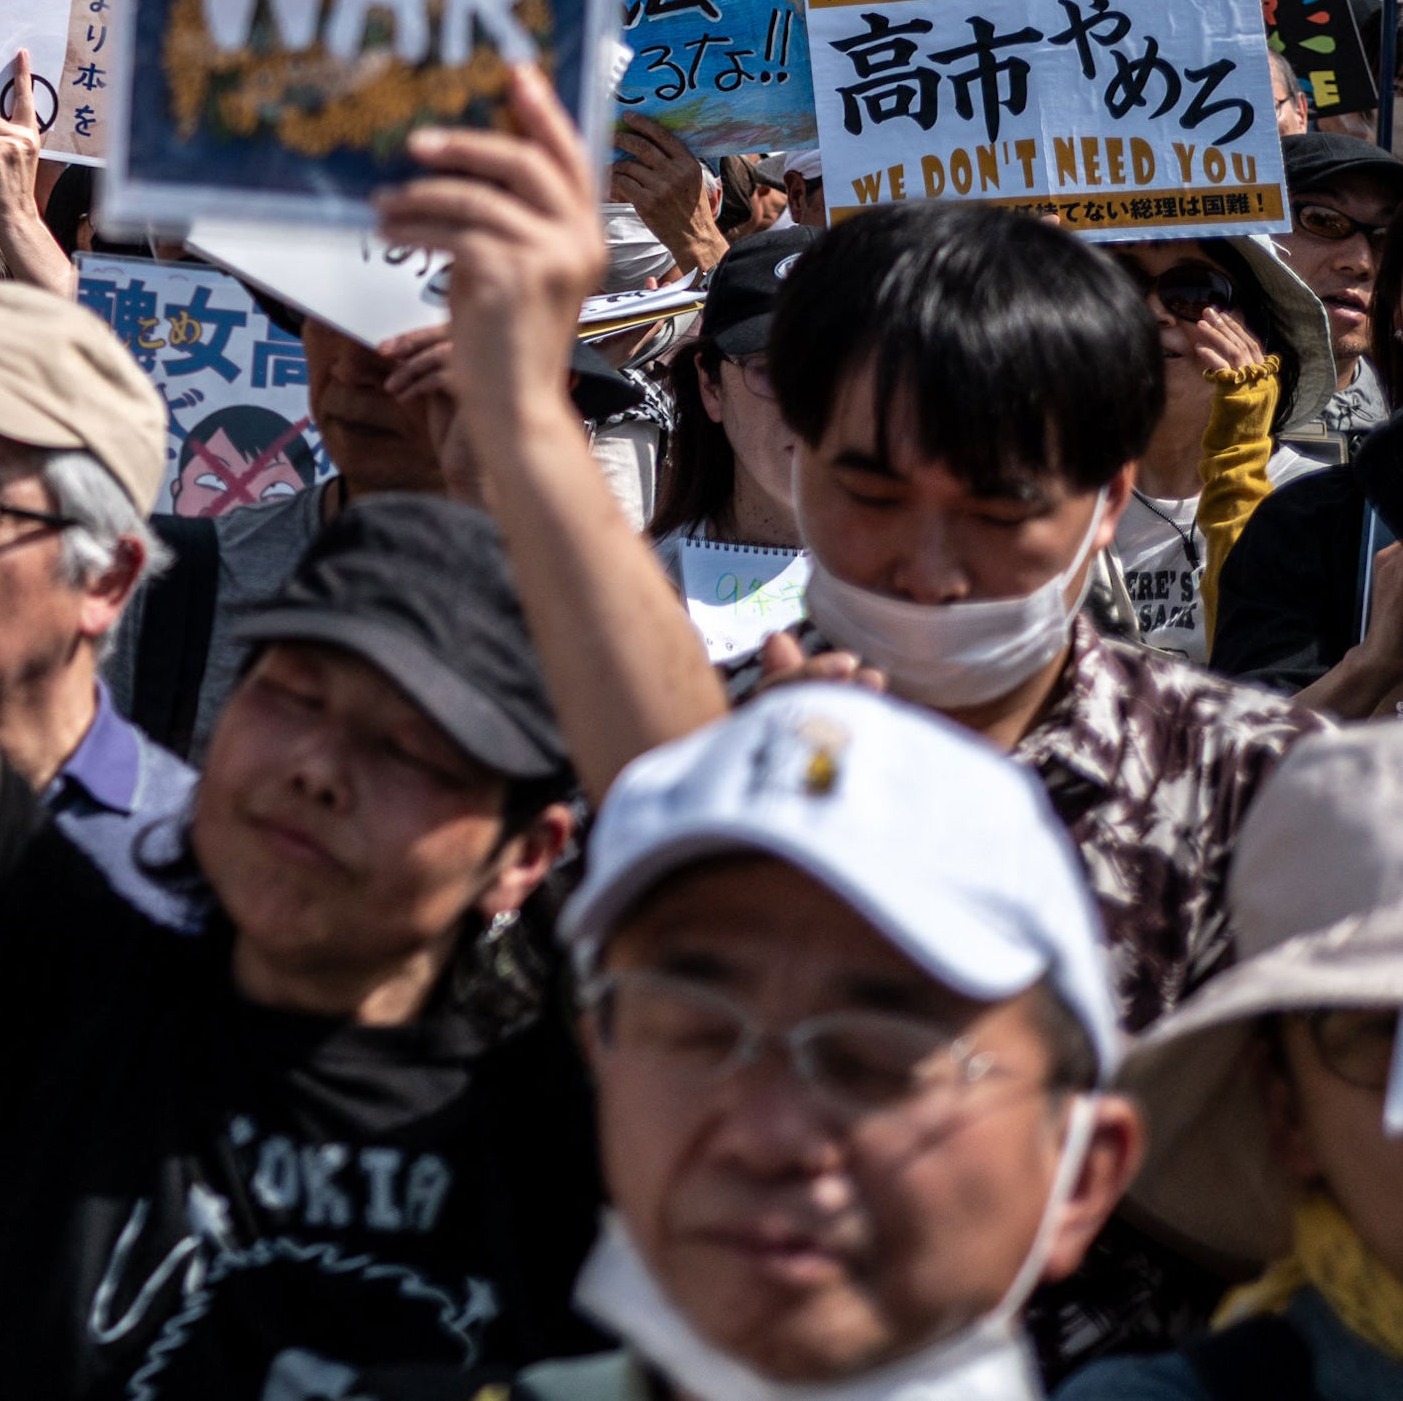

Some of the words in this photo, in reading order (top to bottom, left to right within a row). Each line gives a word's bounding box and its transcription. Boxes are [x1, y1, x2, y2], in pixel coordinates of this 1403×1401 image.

[616, 9, 793, 103] るな!!
[851, 163, 907, 205] WE
[921, 138, 1037, 199] DON'T
[1053, 136, 1156, 187] NEED
[1171, 141, 1258, 185] YOU
